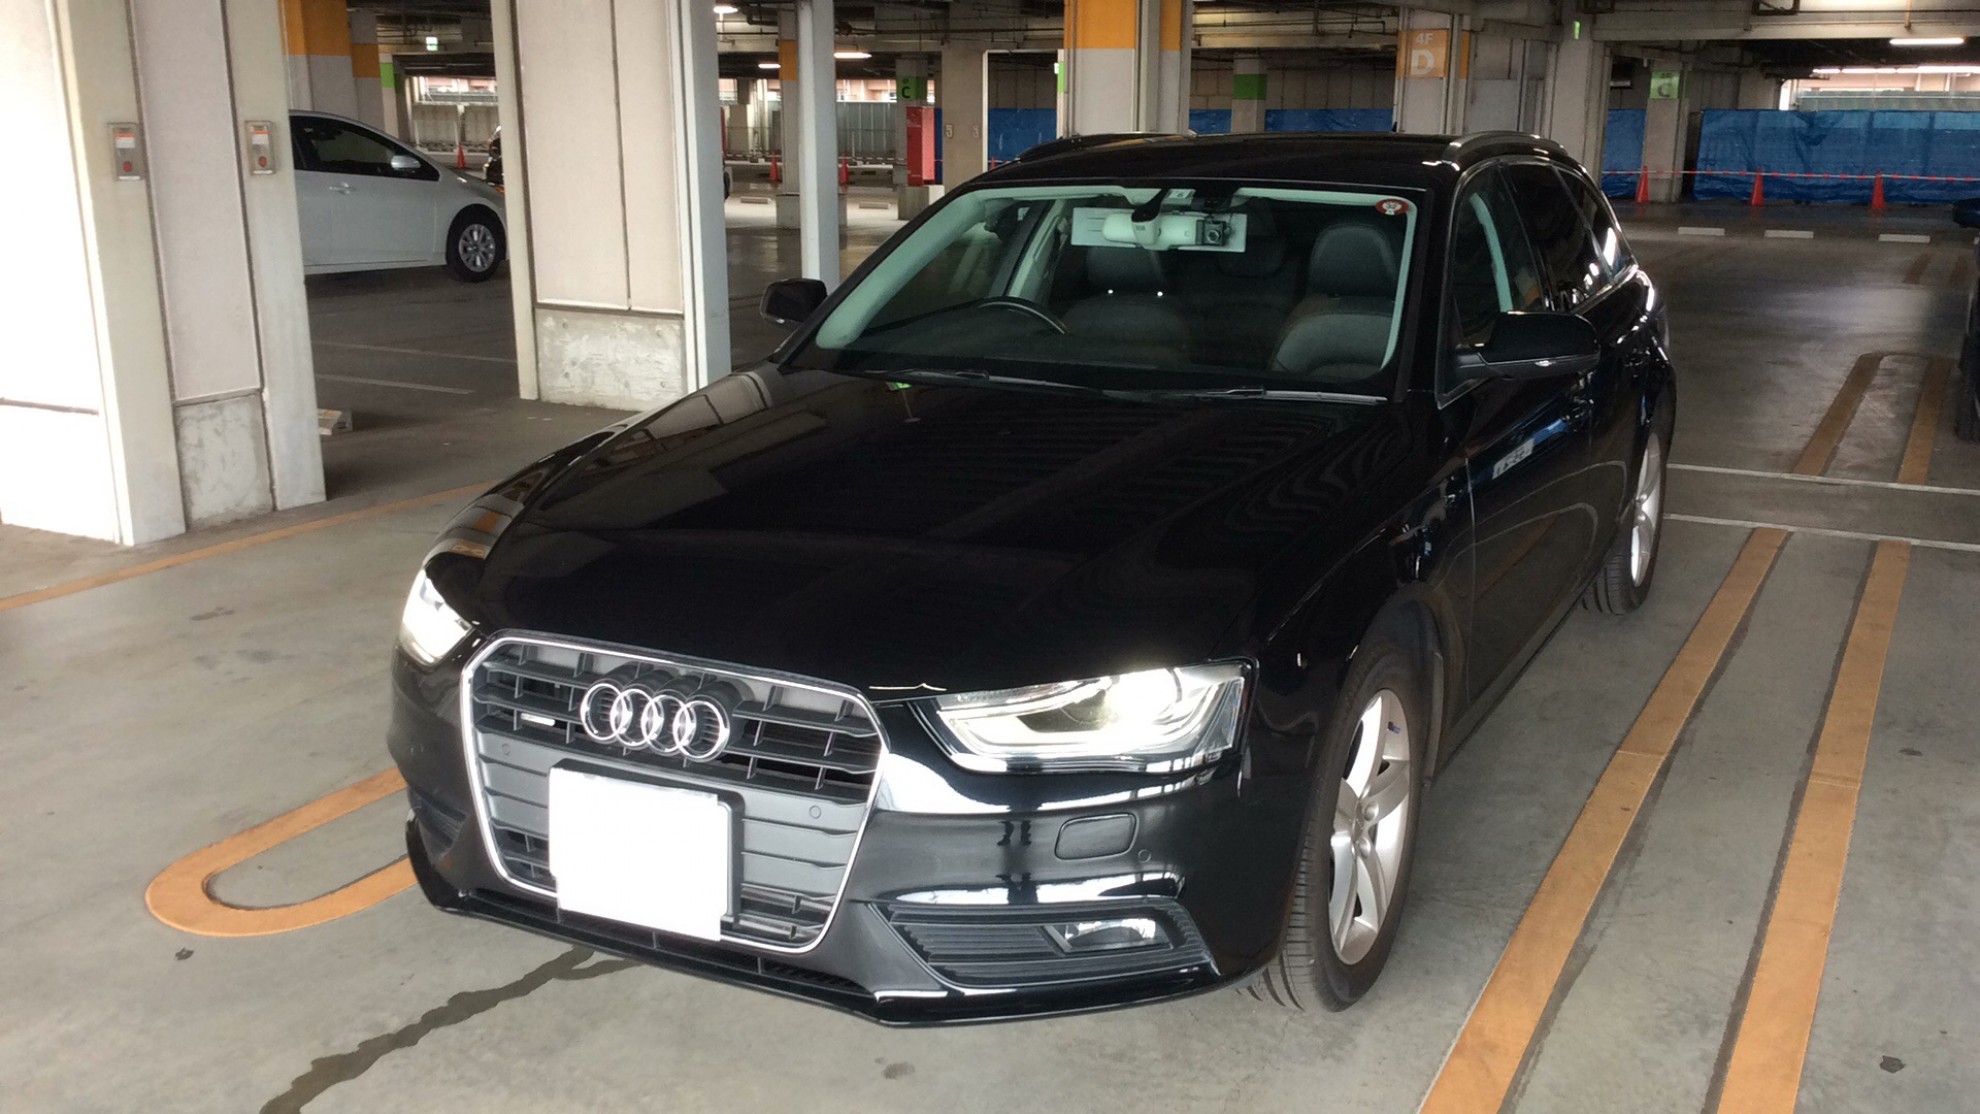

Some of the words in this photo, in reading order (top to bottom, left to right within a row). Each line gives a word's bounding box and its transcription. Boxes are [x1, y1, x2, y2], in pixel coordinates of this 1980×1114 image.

[1415, 33, 1434, 45] 4F
[1411, 49, 1435, 76] D
[902, 86, 911, 99] C
[1658, 83, 1673, 98] C
